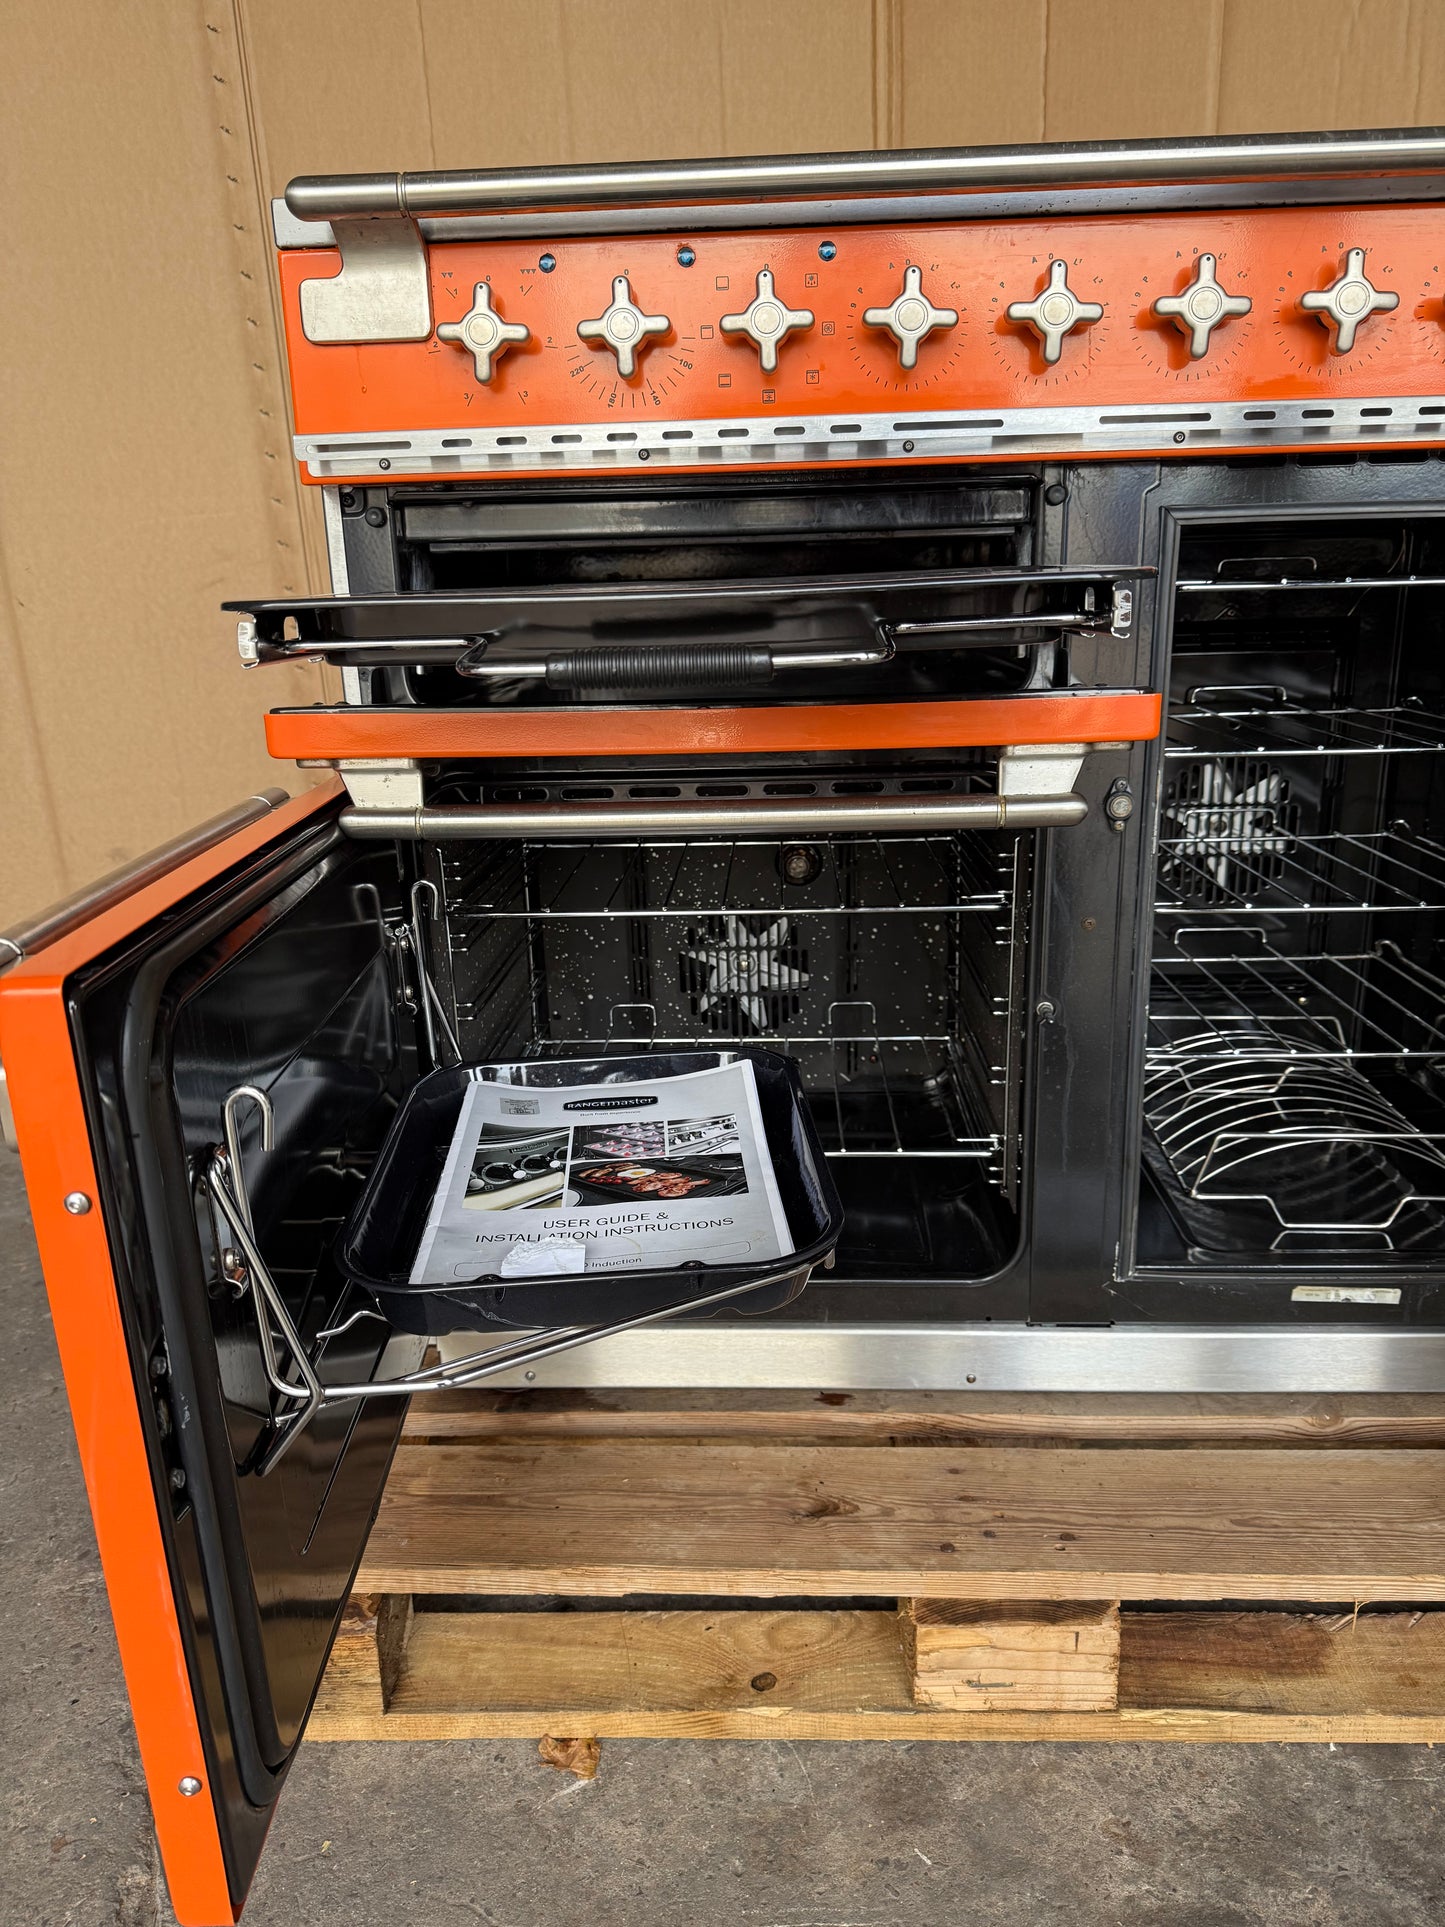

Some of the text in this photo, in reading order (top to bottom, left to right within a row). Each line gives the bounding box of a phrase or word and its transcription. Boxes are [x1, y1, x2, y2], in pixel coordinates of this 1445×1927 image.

[678, 358, 693, 370] 100
[569, 365, 585, 378] 220
[608, 393, 617, 408] 180
[650, 391, 661, 406] 140
[567, 1098, 654, 1109] RANGEmaster
[543, 1211, 669, 1229] USER GUIDE &
[604, 1217, 734, 1237] INSTRUCTIONS
[591, 1257, 642, 1268] Induction
